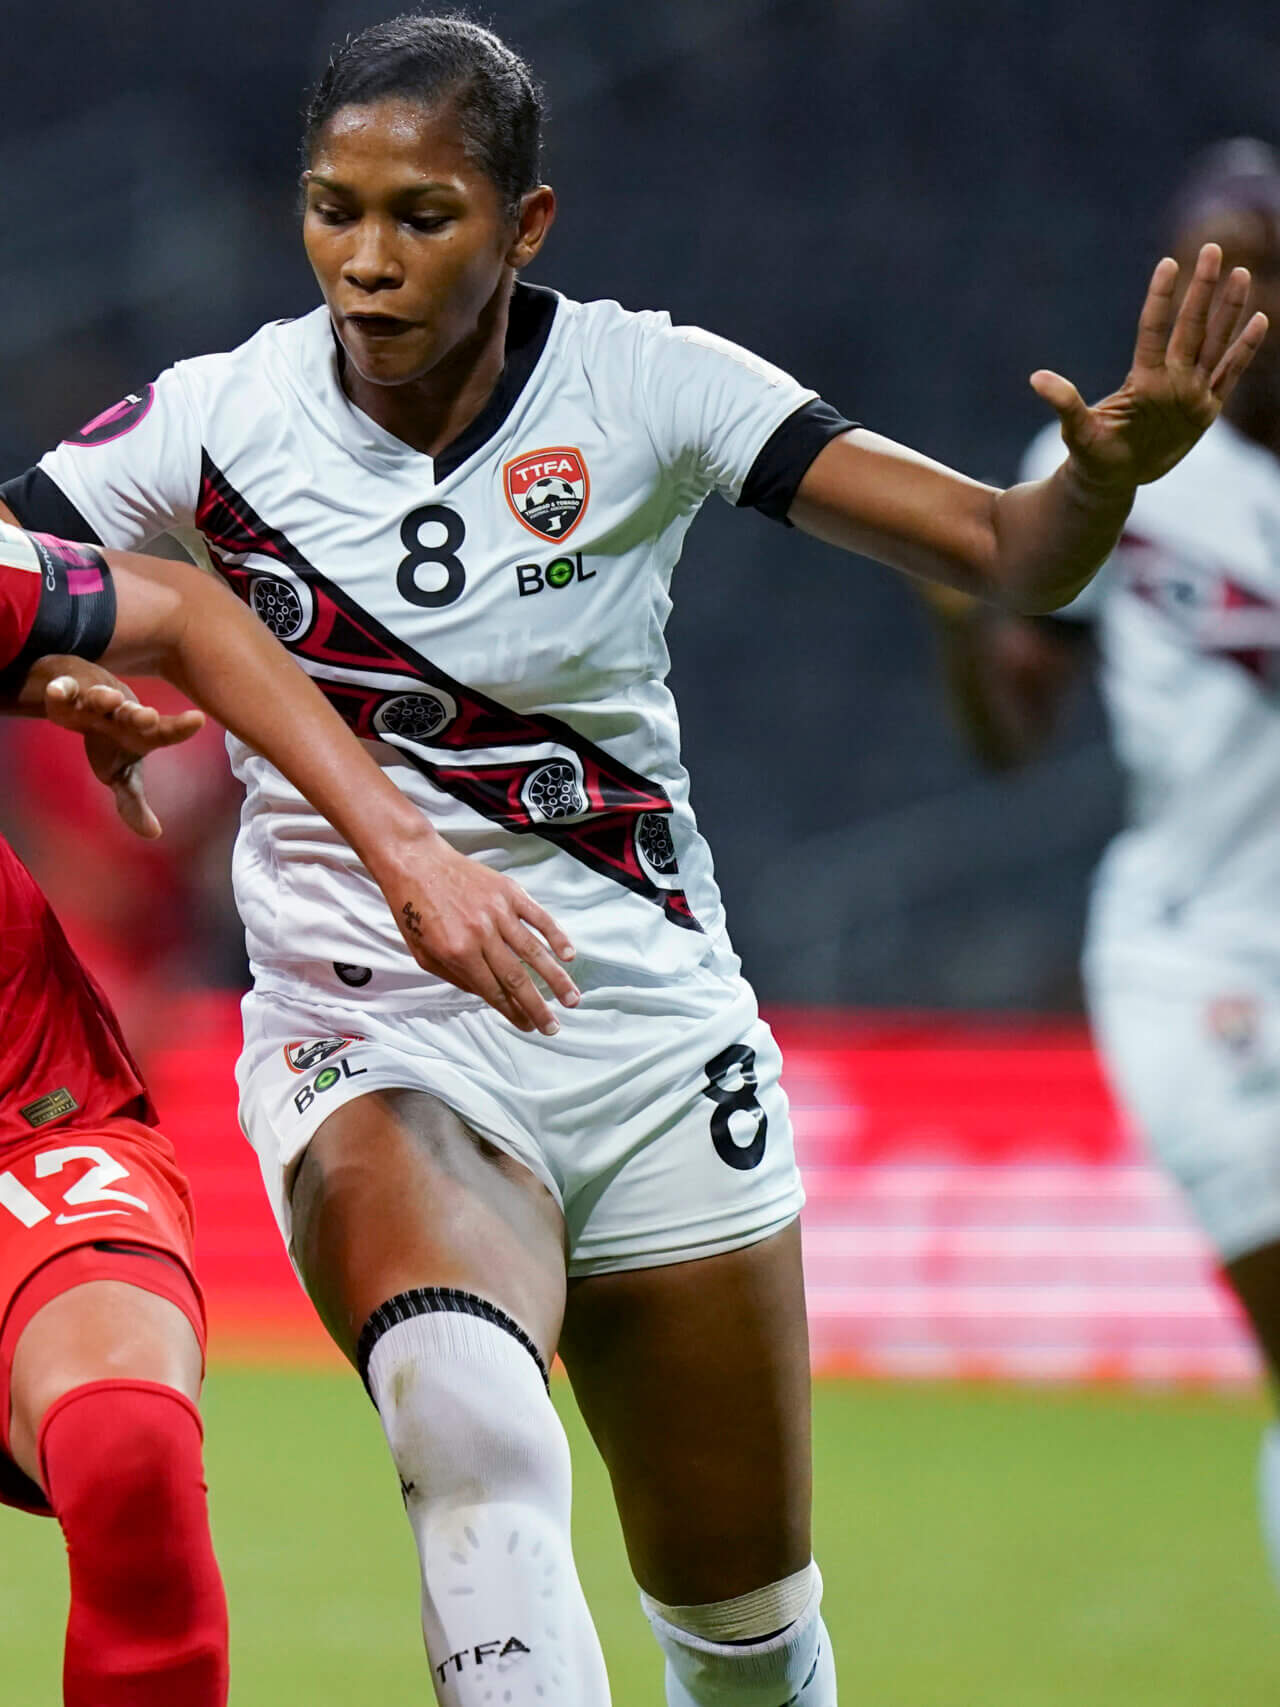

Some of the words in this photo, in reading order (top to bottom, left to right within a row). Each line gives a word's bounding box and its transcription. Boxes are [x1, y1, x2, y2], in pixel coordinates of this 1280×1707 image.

[515, 459, 574, 481] TTFA
[396, 504, 466, 608] 8
[702, 1044, 768, 1171] 8
[436, 1636, 531, 1684] TTFA
